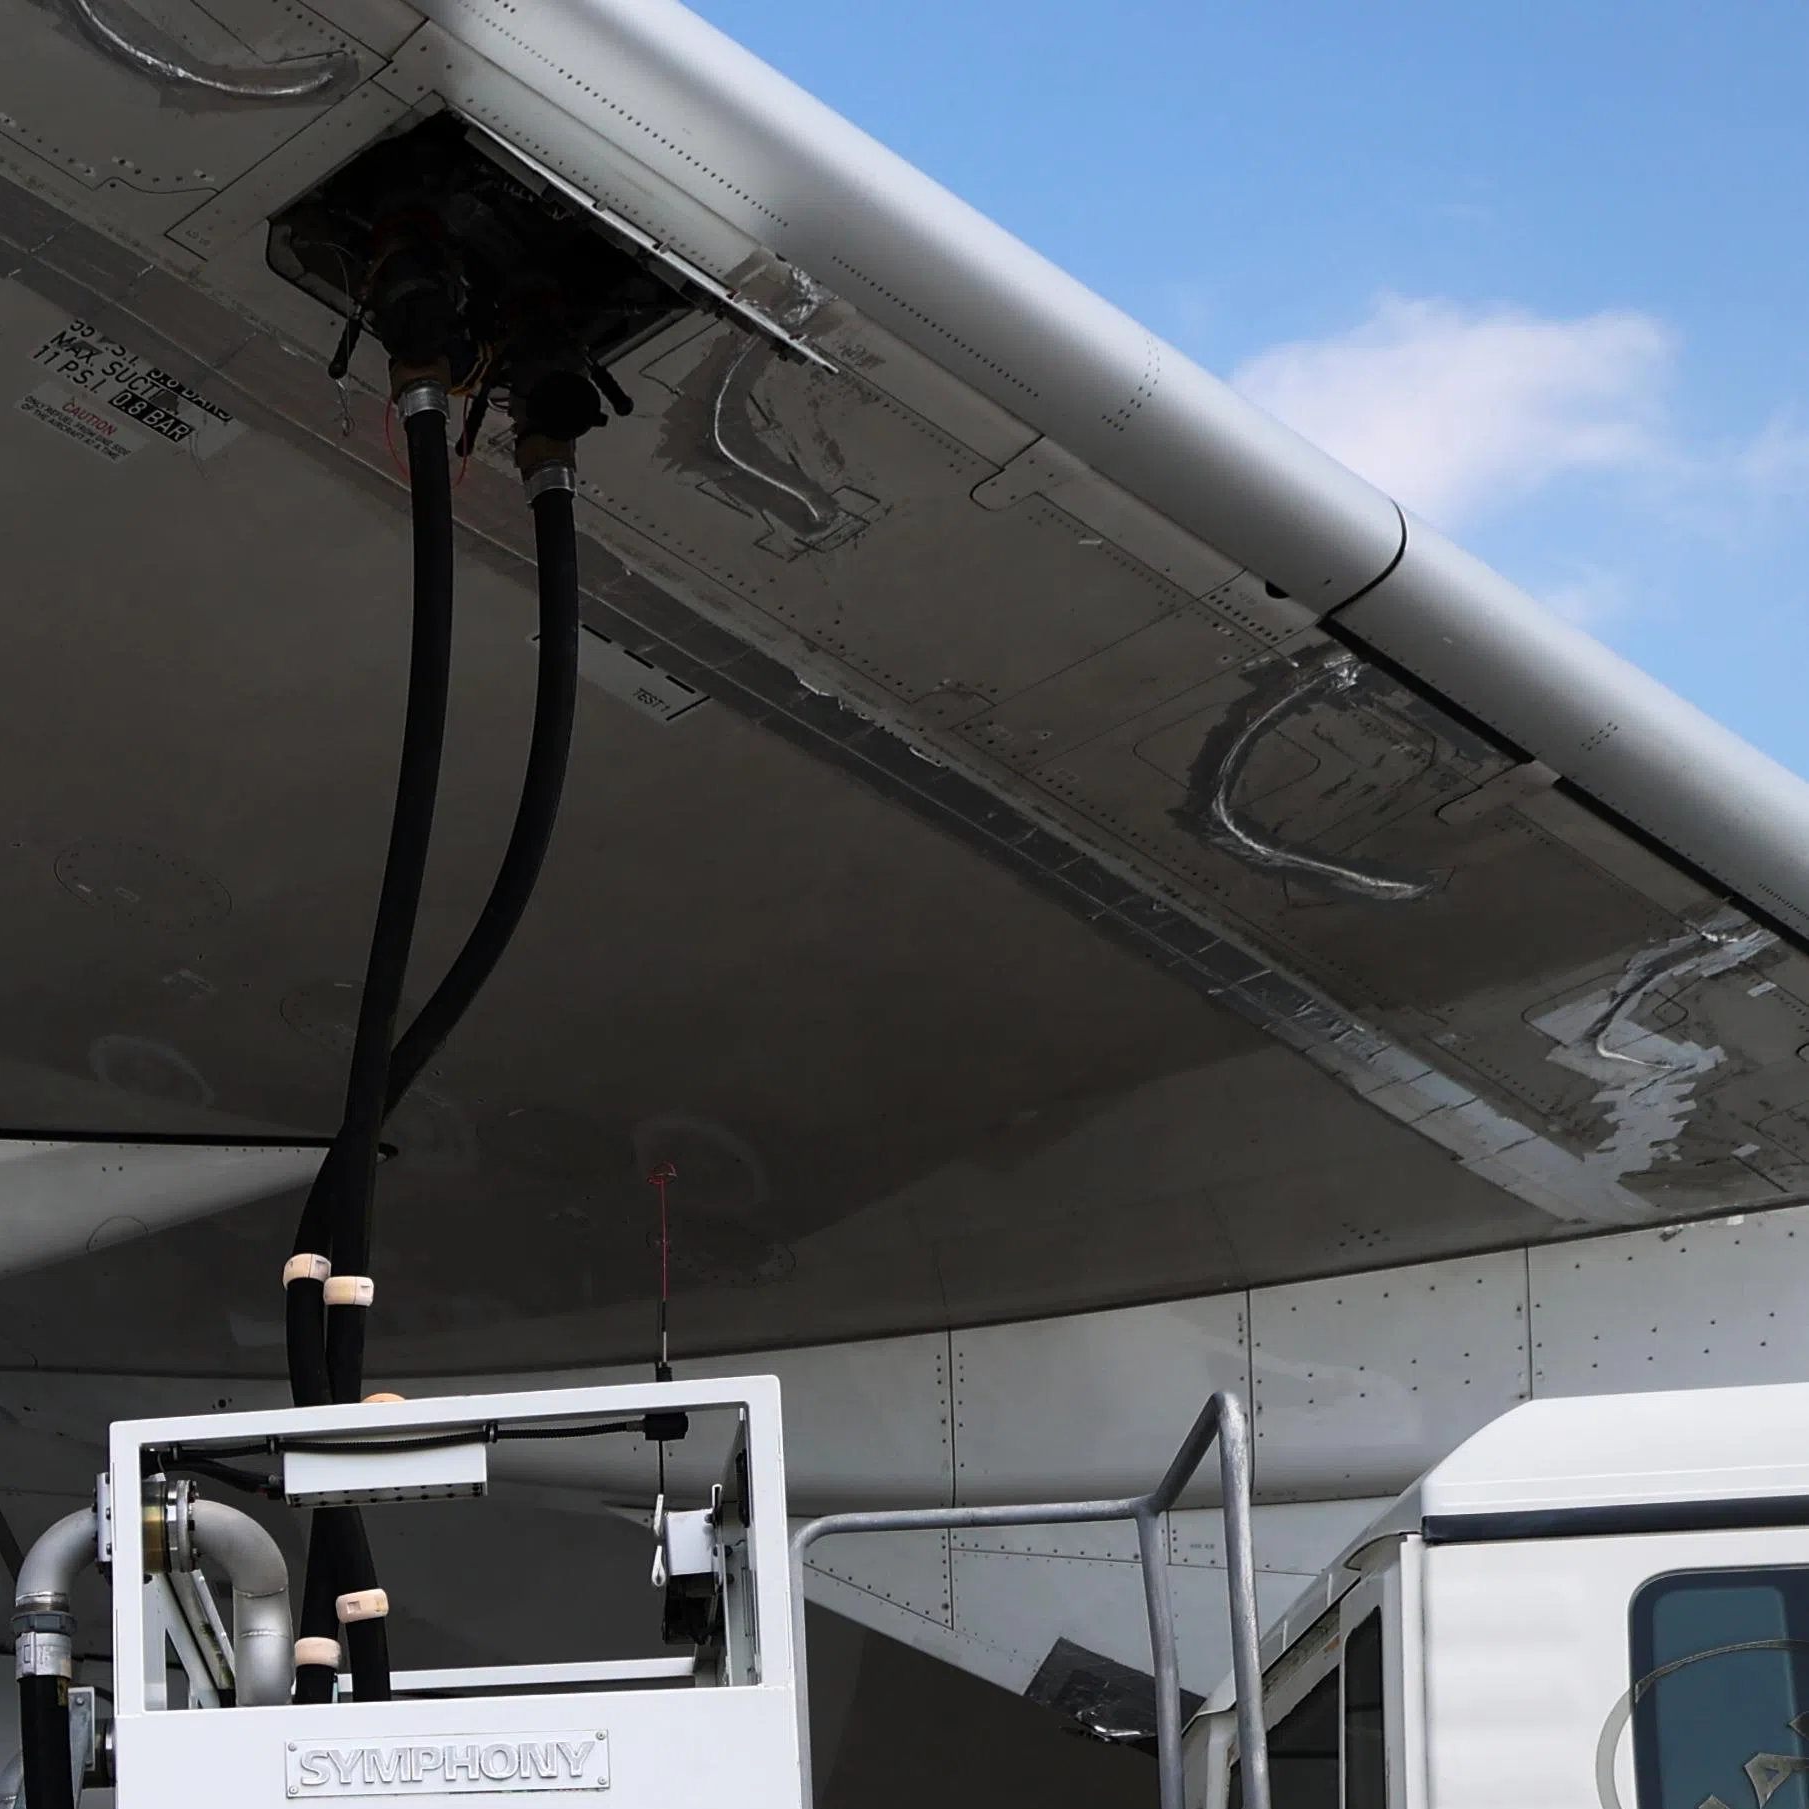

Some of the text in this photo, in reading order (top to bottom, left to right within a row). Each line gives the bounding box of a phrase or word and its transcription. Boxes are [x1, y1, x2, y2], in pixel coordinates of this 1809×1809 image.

[62, 402, 118, 437] CAUTION
[113, 392, 147, 416] 0.8
[143, 409, 189, 441] BAR
[298, 1739, 597, 1786] SYMPHONY
